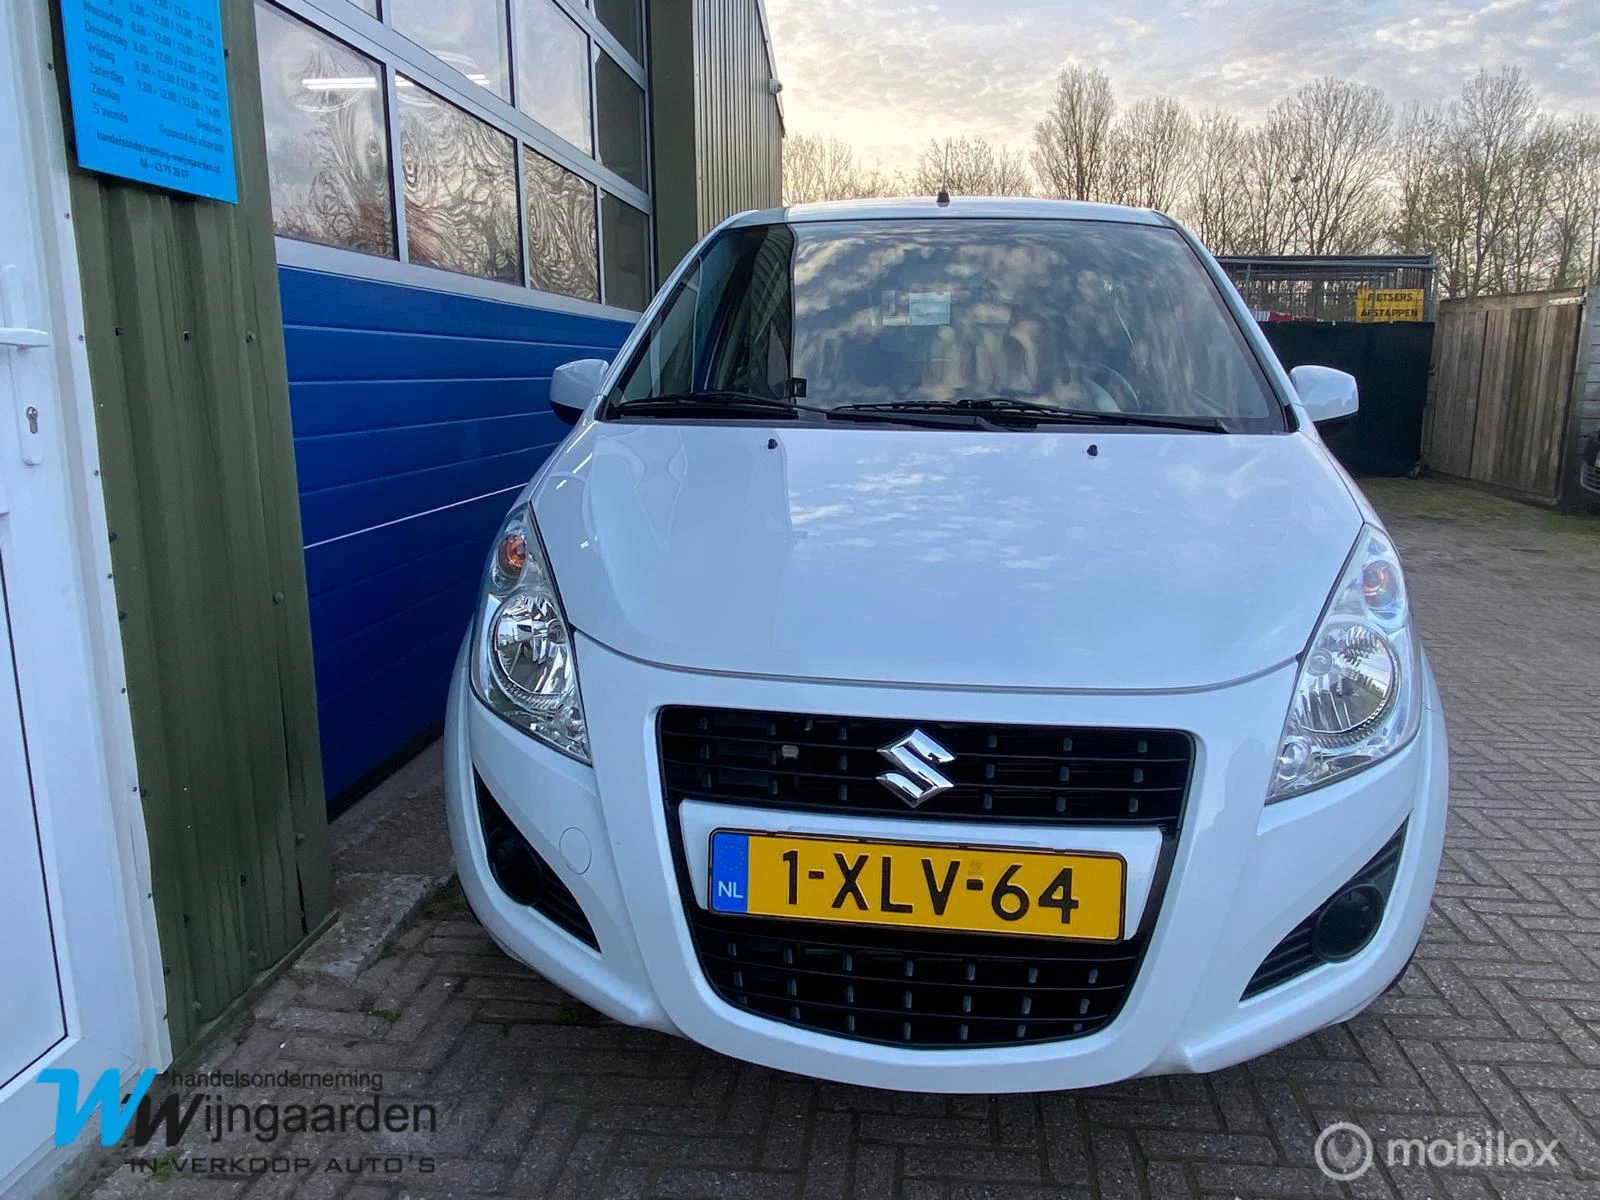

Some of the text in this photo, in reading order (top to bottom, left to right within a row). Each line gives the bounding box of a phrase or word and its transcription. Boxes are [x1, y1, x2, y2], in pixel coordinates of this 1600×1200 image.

[84, 20, 128, 51] Donderdag
[86, 41, 115, 65] Vrijdag
[88, 61, 125, 87] Zaterdag
[91, 82, 121, 105] Zondag
[1367, 293, 1413, 302] FETSERS
[1361, 308, 1418, 317] AFSTAPPEN
[717, 880, 744, 900] NL
[781, 849, 1080, 925] 1-XLV-64
